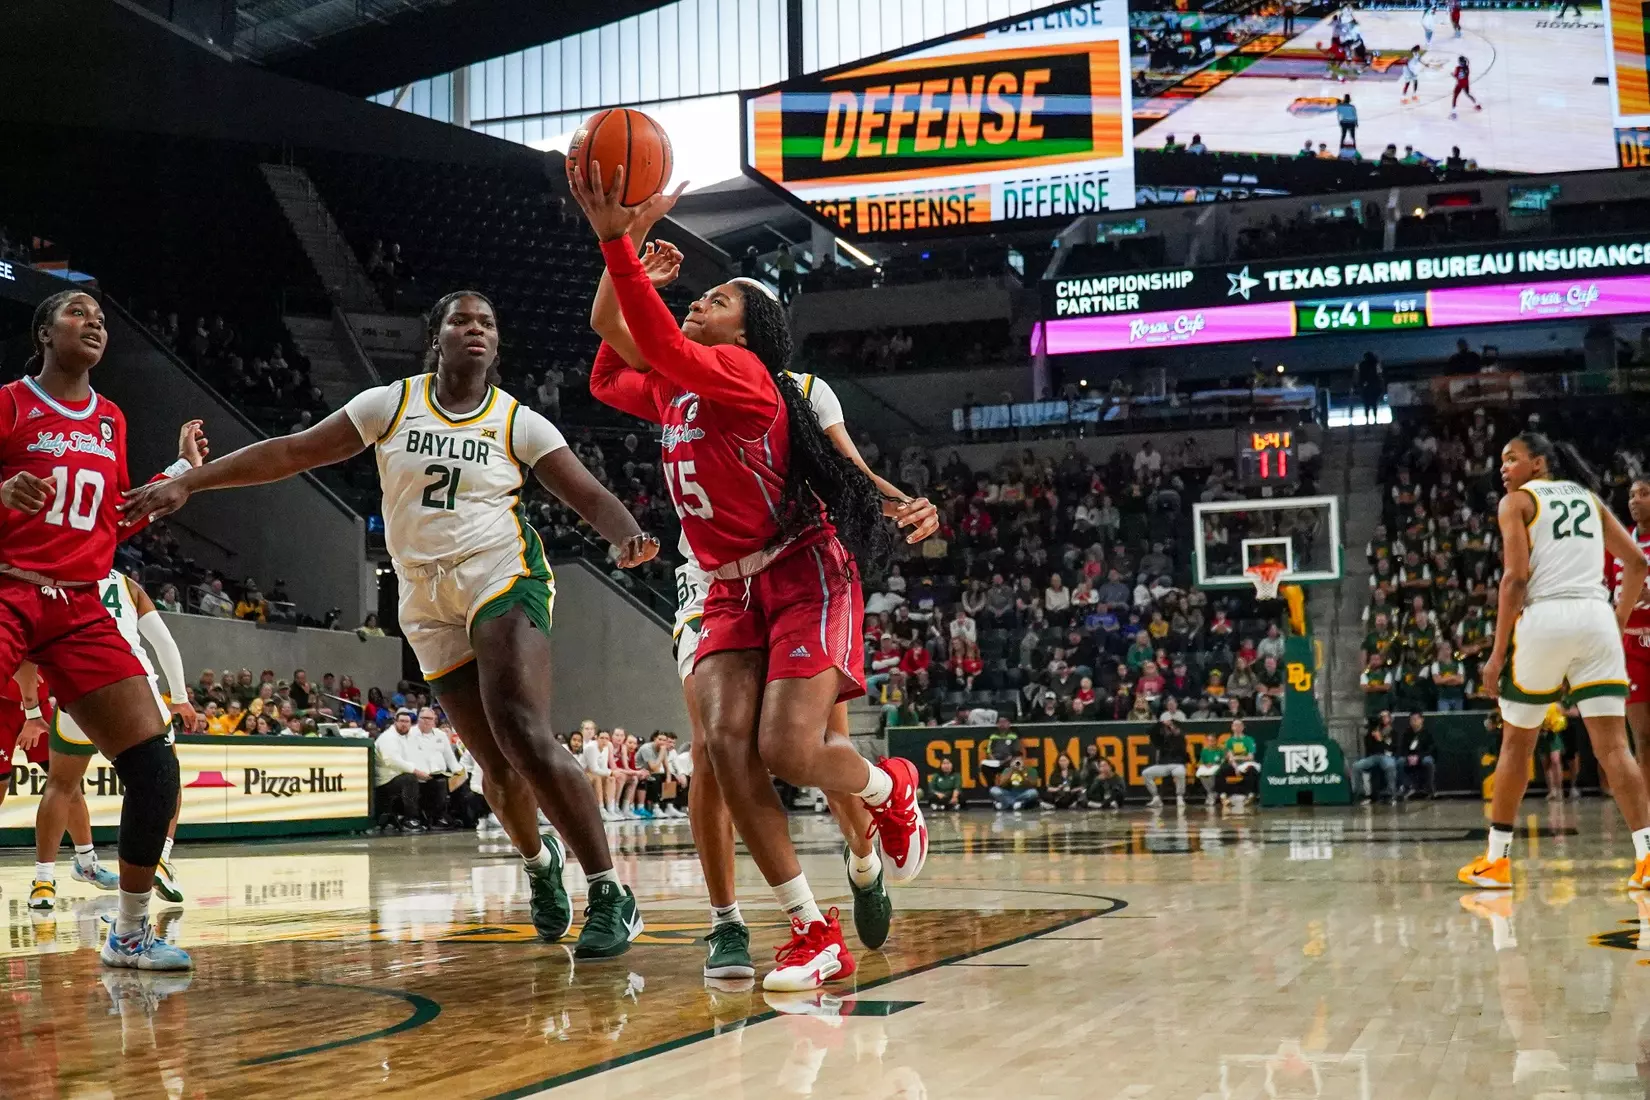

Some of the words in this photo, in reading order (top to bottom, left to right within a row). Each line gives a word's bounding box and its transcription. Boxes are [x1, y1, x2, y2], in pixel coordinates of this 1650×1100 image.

[822, 68, 1051, 161] DEFENSE
[868, 192, 976, 232] DEFENSE
[1003, 178, 1109, 220] DEFENSE
[1056, 270, 1194, 298] CHAMPIONSHIP
[1264, 266, 1341, 291] TEXAS
[1345, 260, 1412, 285] FARM
[1416, 252, 1514, 280] BUREAU
[1056, 293, 1140, 316] PARTNER
[1313, 300, 1371, 330] 6:41
[1393, 299, 1417, 313] 1ST
[27, 431, 68, 458] Lady
[406, 430, 489, 465] BAYLOR
[1252, 431, 1291, 451] 6:41
[1259, 450, 1288, 479] 11
[44, 466, 105, 531] 10
[421, 464, 461, 510] 21
[663, 460, 714, 520] 15
[1549, 499, 1594, 540] 22
[1286, 662, 1312, 692] BU
[244, 767, 301, 797] Pizza
[302, 767, 347, 793] Hut
[1267, 775, 1288, 786] Your
[1288, 775, 1310, 785] Bank
[1311, 774, 1324, 785] for
[1324, 773, 1342, 784] Life
